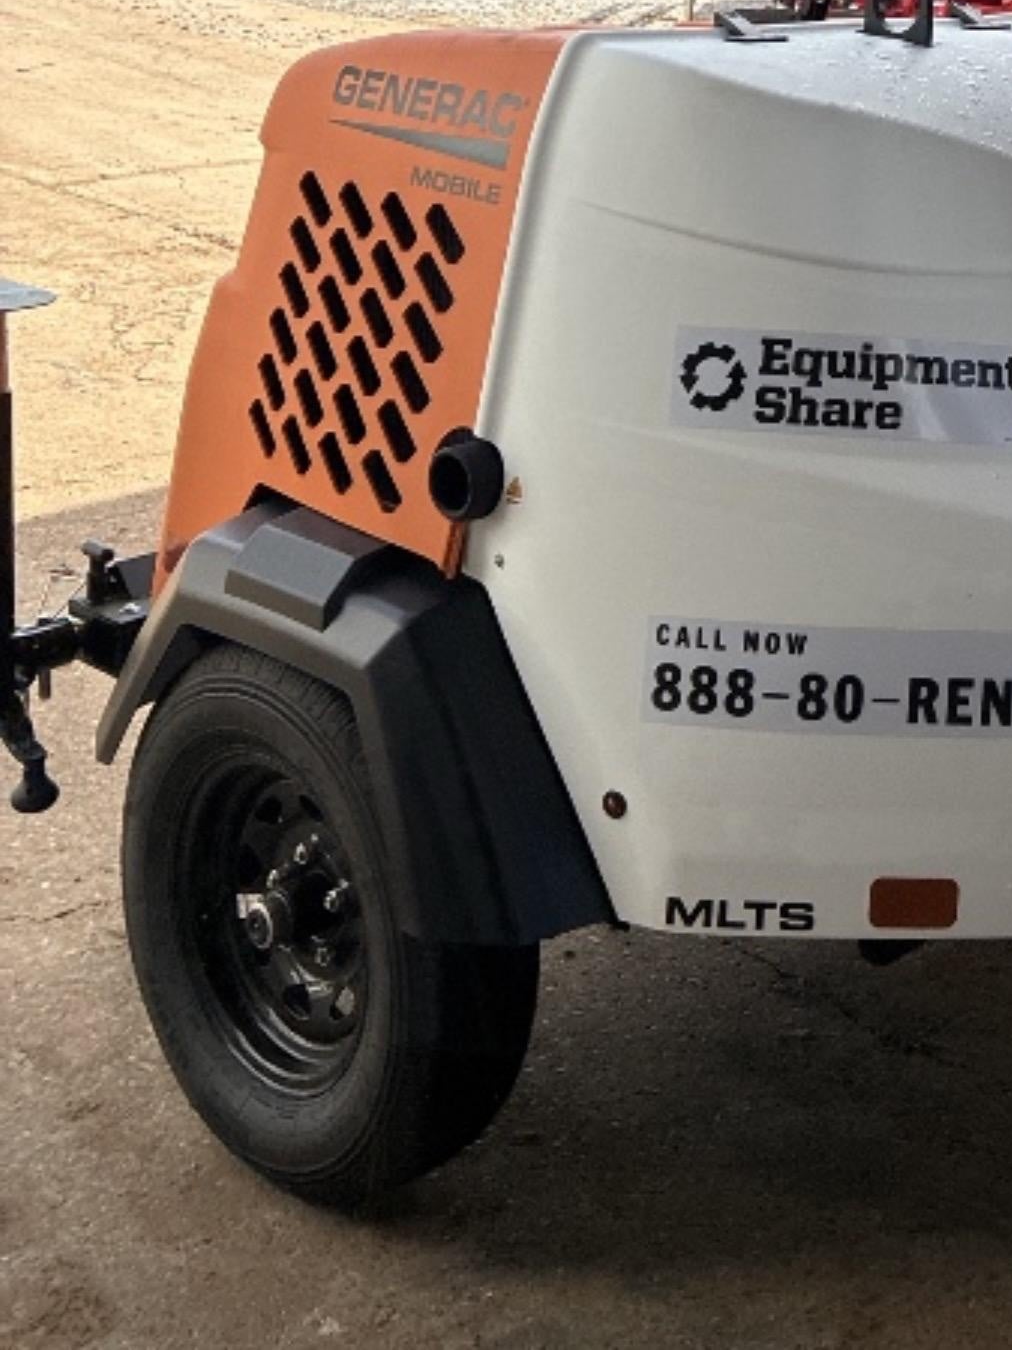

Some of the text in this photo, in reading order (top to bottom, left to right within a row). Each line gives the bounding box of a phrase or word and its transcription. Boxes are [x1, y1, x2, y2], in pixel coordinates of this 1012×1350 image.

[333, 65, 523, 138] GENERAC
[409, 165, 503, 204] MOBILE
[754, 385, 903, 430] Share
[655, 623, 808, 656] CALL NOW
[664, 896, 815, 931] MLTS
